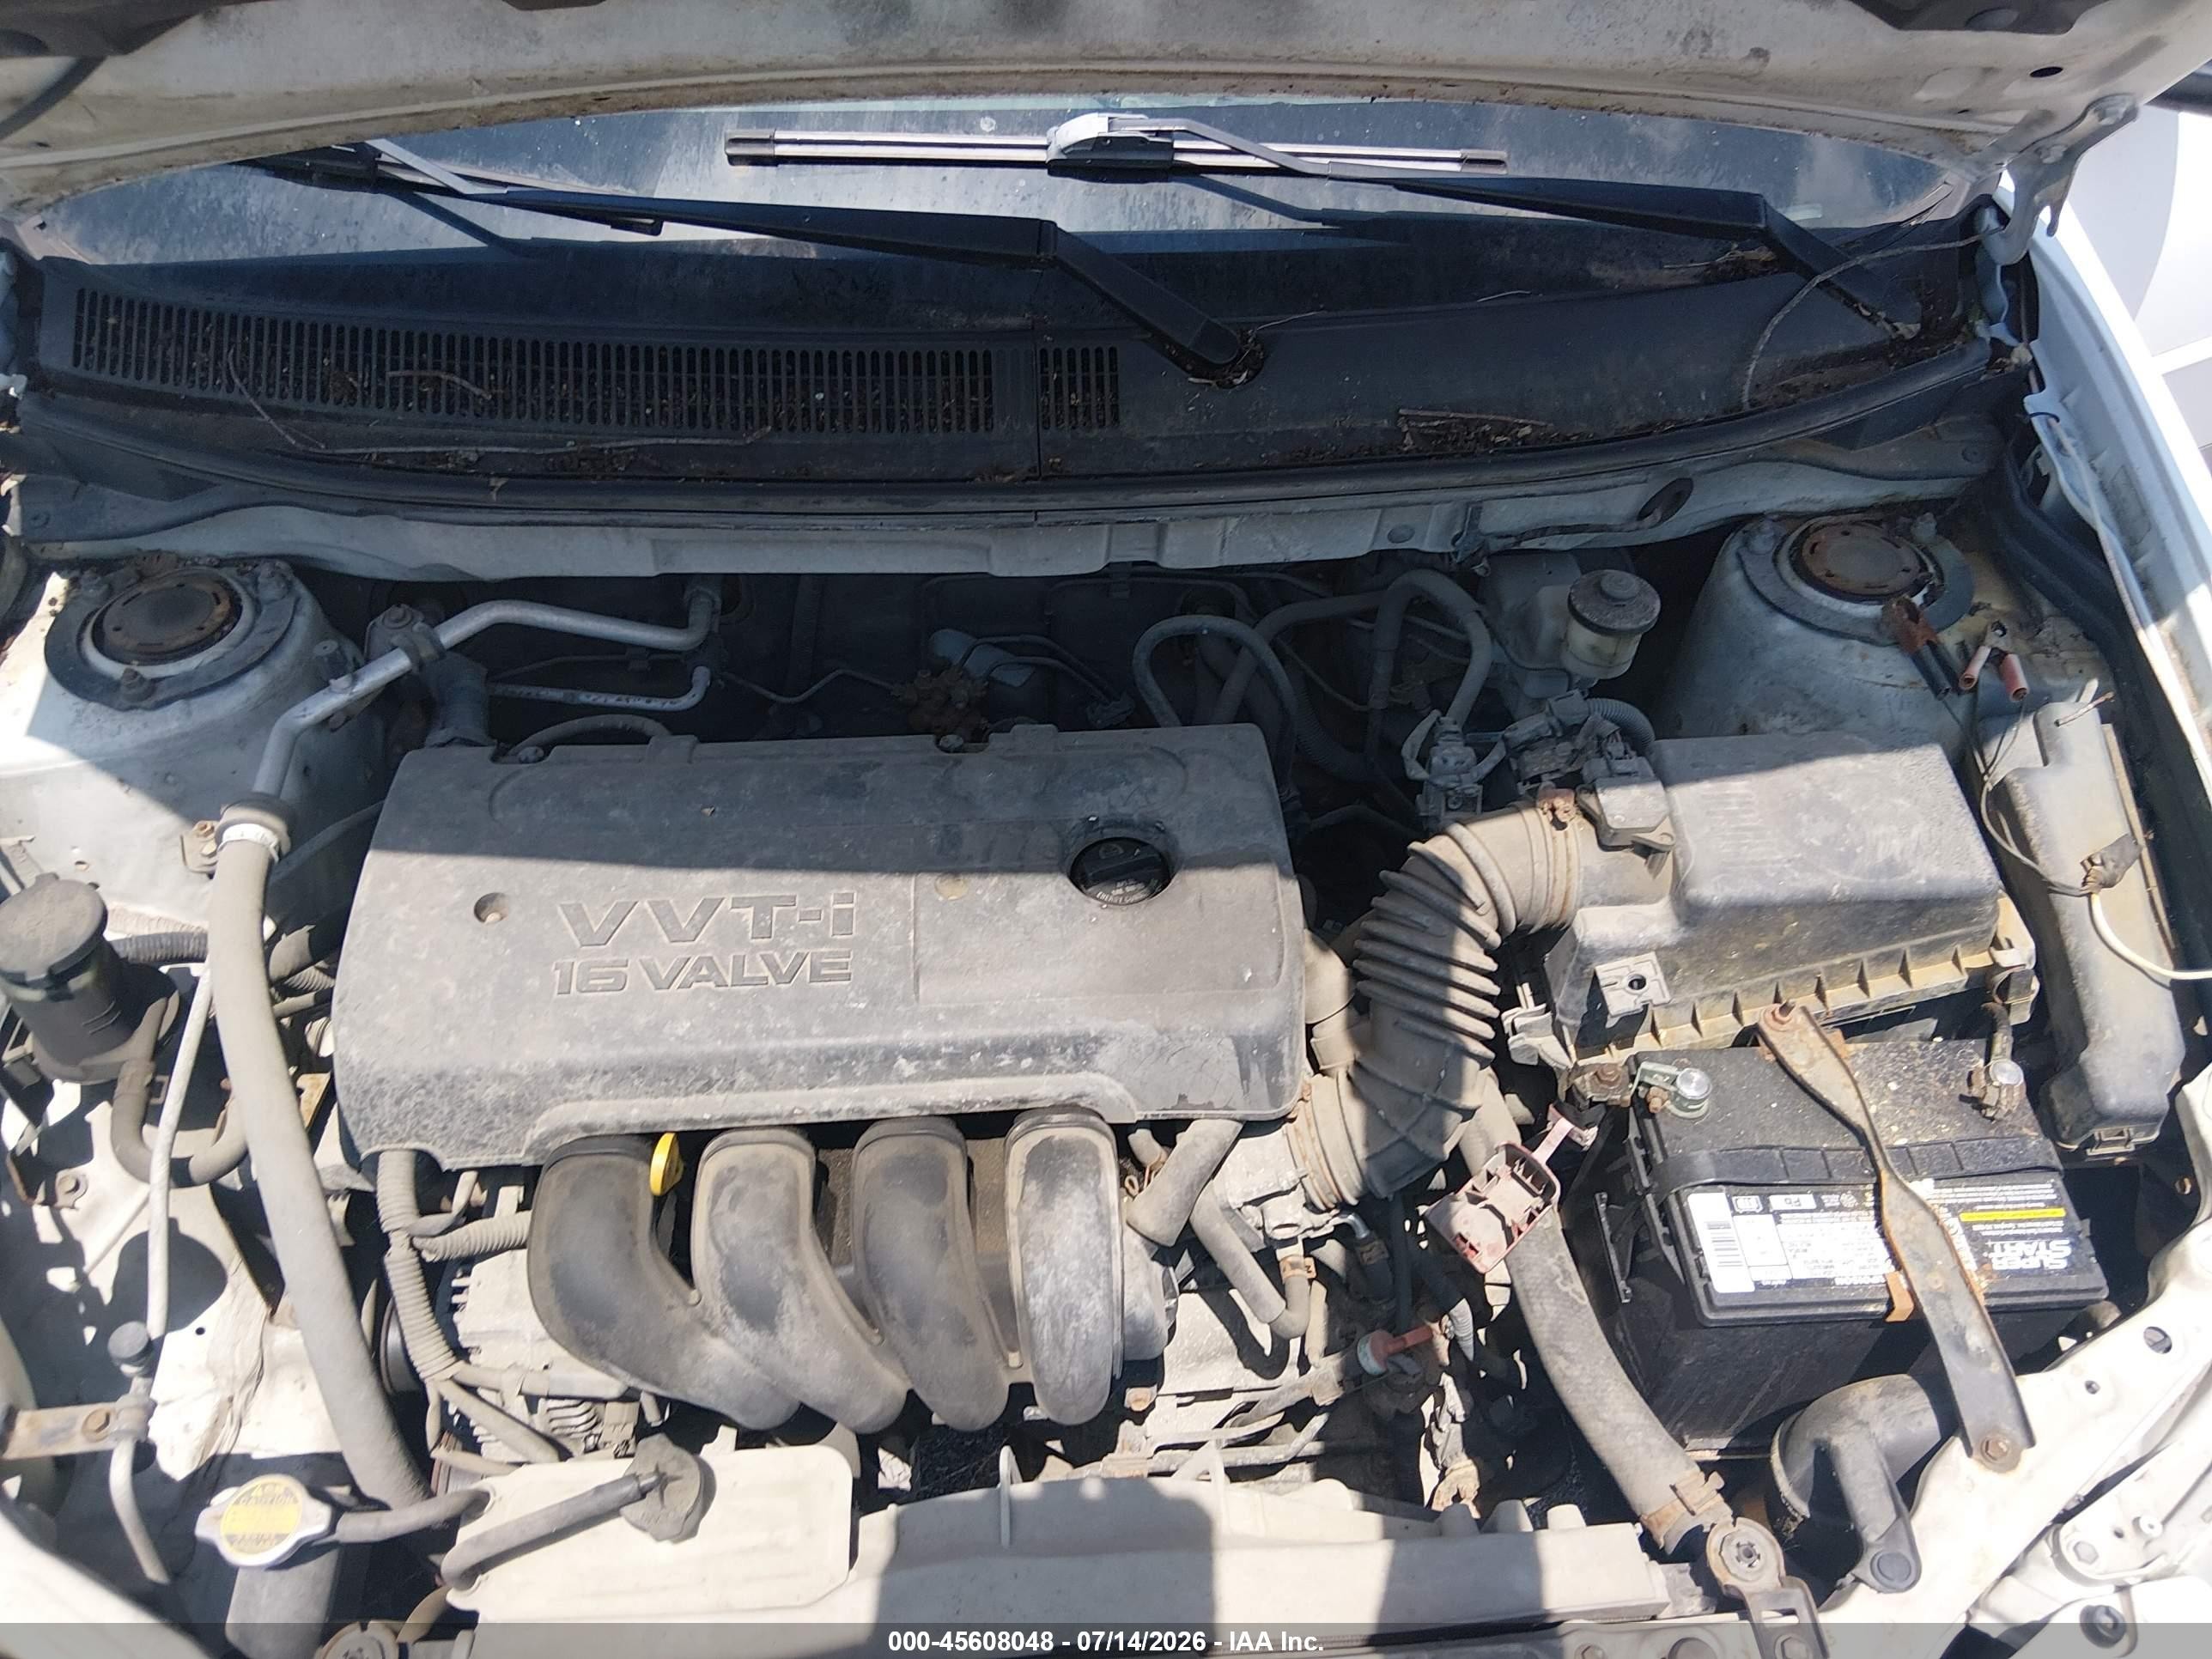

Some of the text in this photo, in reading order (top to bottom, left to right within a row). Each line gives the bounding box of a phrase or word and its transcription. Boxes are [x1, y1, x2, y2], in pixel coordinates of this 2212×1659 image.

[558, 891, 856, 947] VVT-i
[553, 950, 852, 995] 16 VALVE
[1989, 1240, 2071, 1258] START
[1991, 1255, 2068, 1270] SUPER
